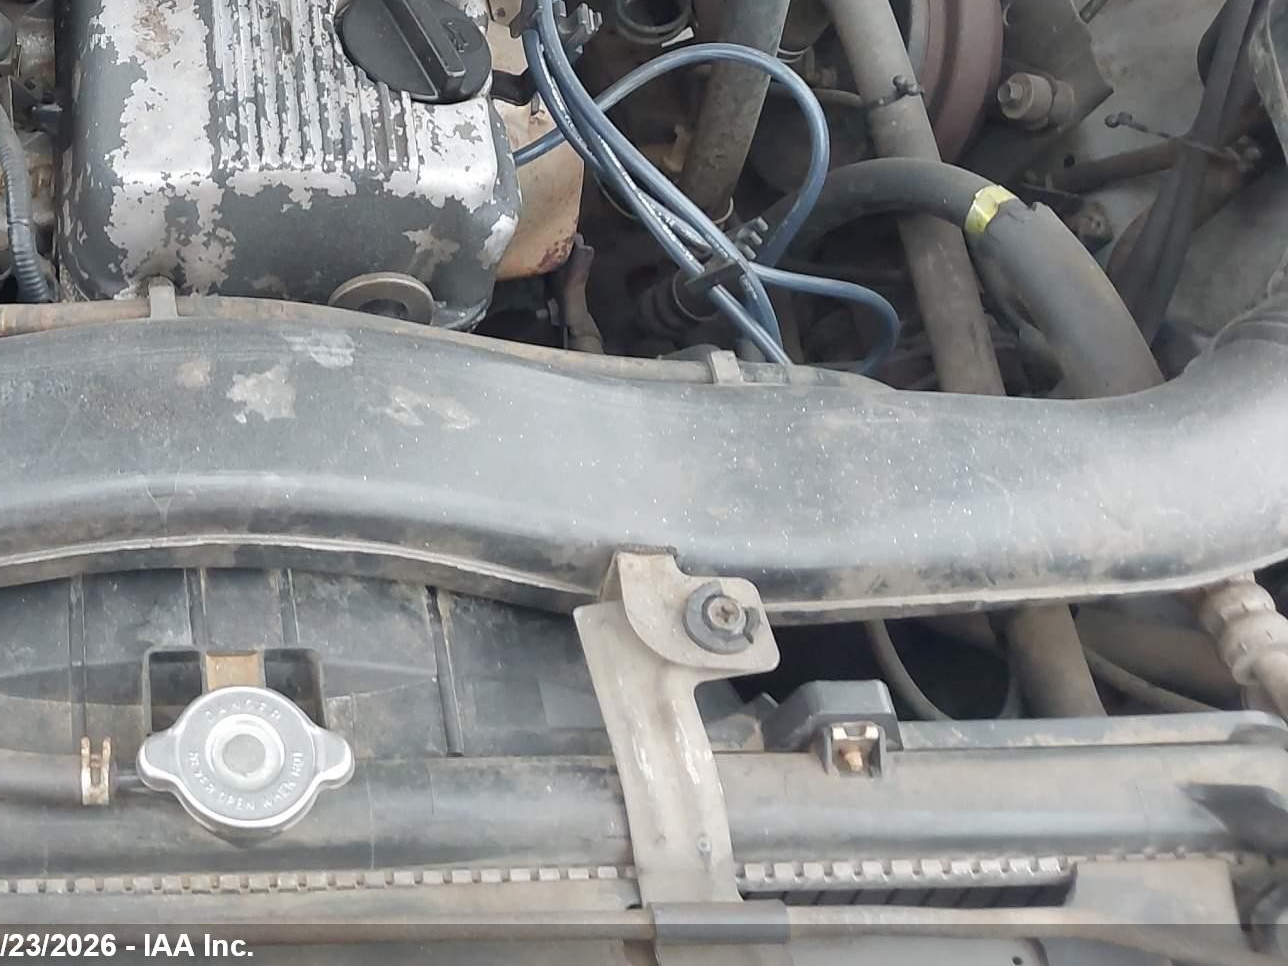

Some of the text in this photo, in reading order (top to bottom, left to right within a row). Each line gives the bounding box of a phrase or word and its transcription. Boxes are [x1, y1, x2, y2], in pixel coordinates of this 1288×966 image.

[205, 699, 282, 723] DANGER
[218, 792, 257, 811] OPEN
[263, 780, 297, 811] WHEN
